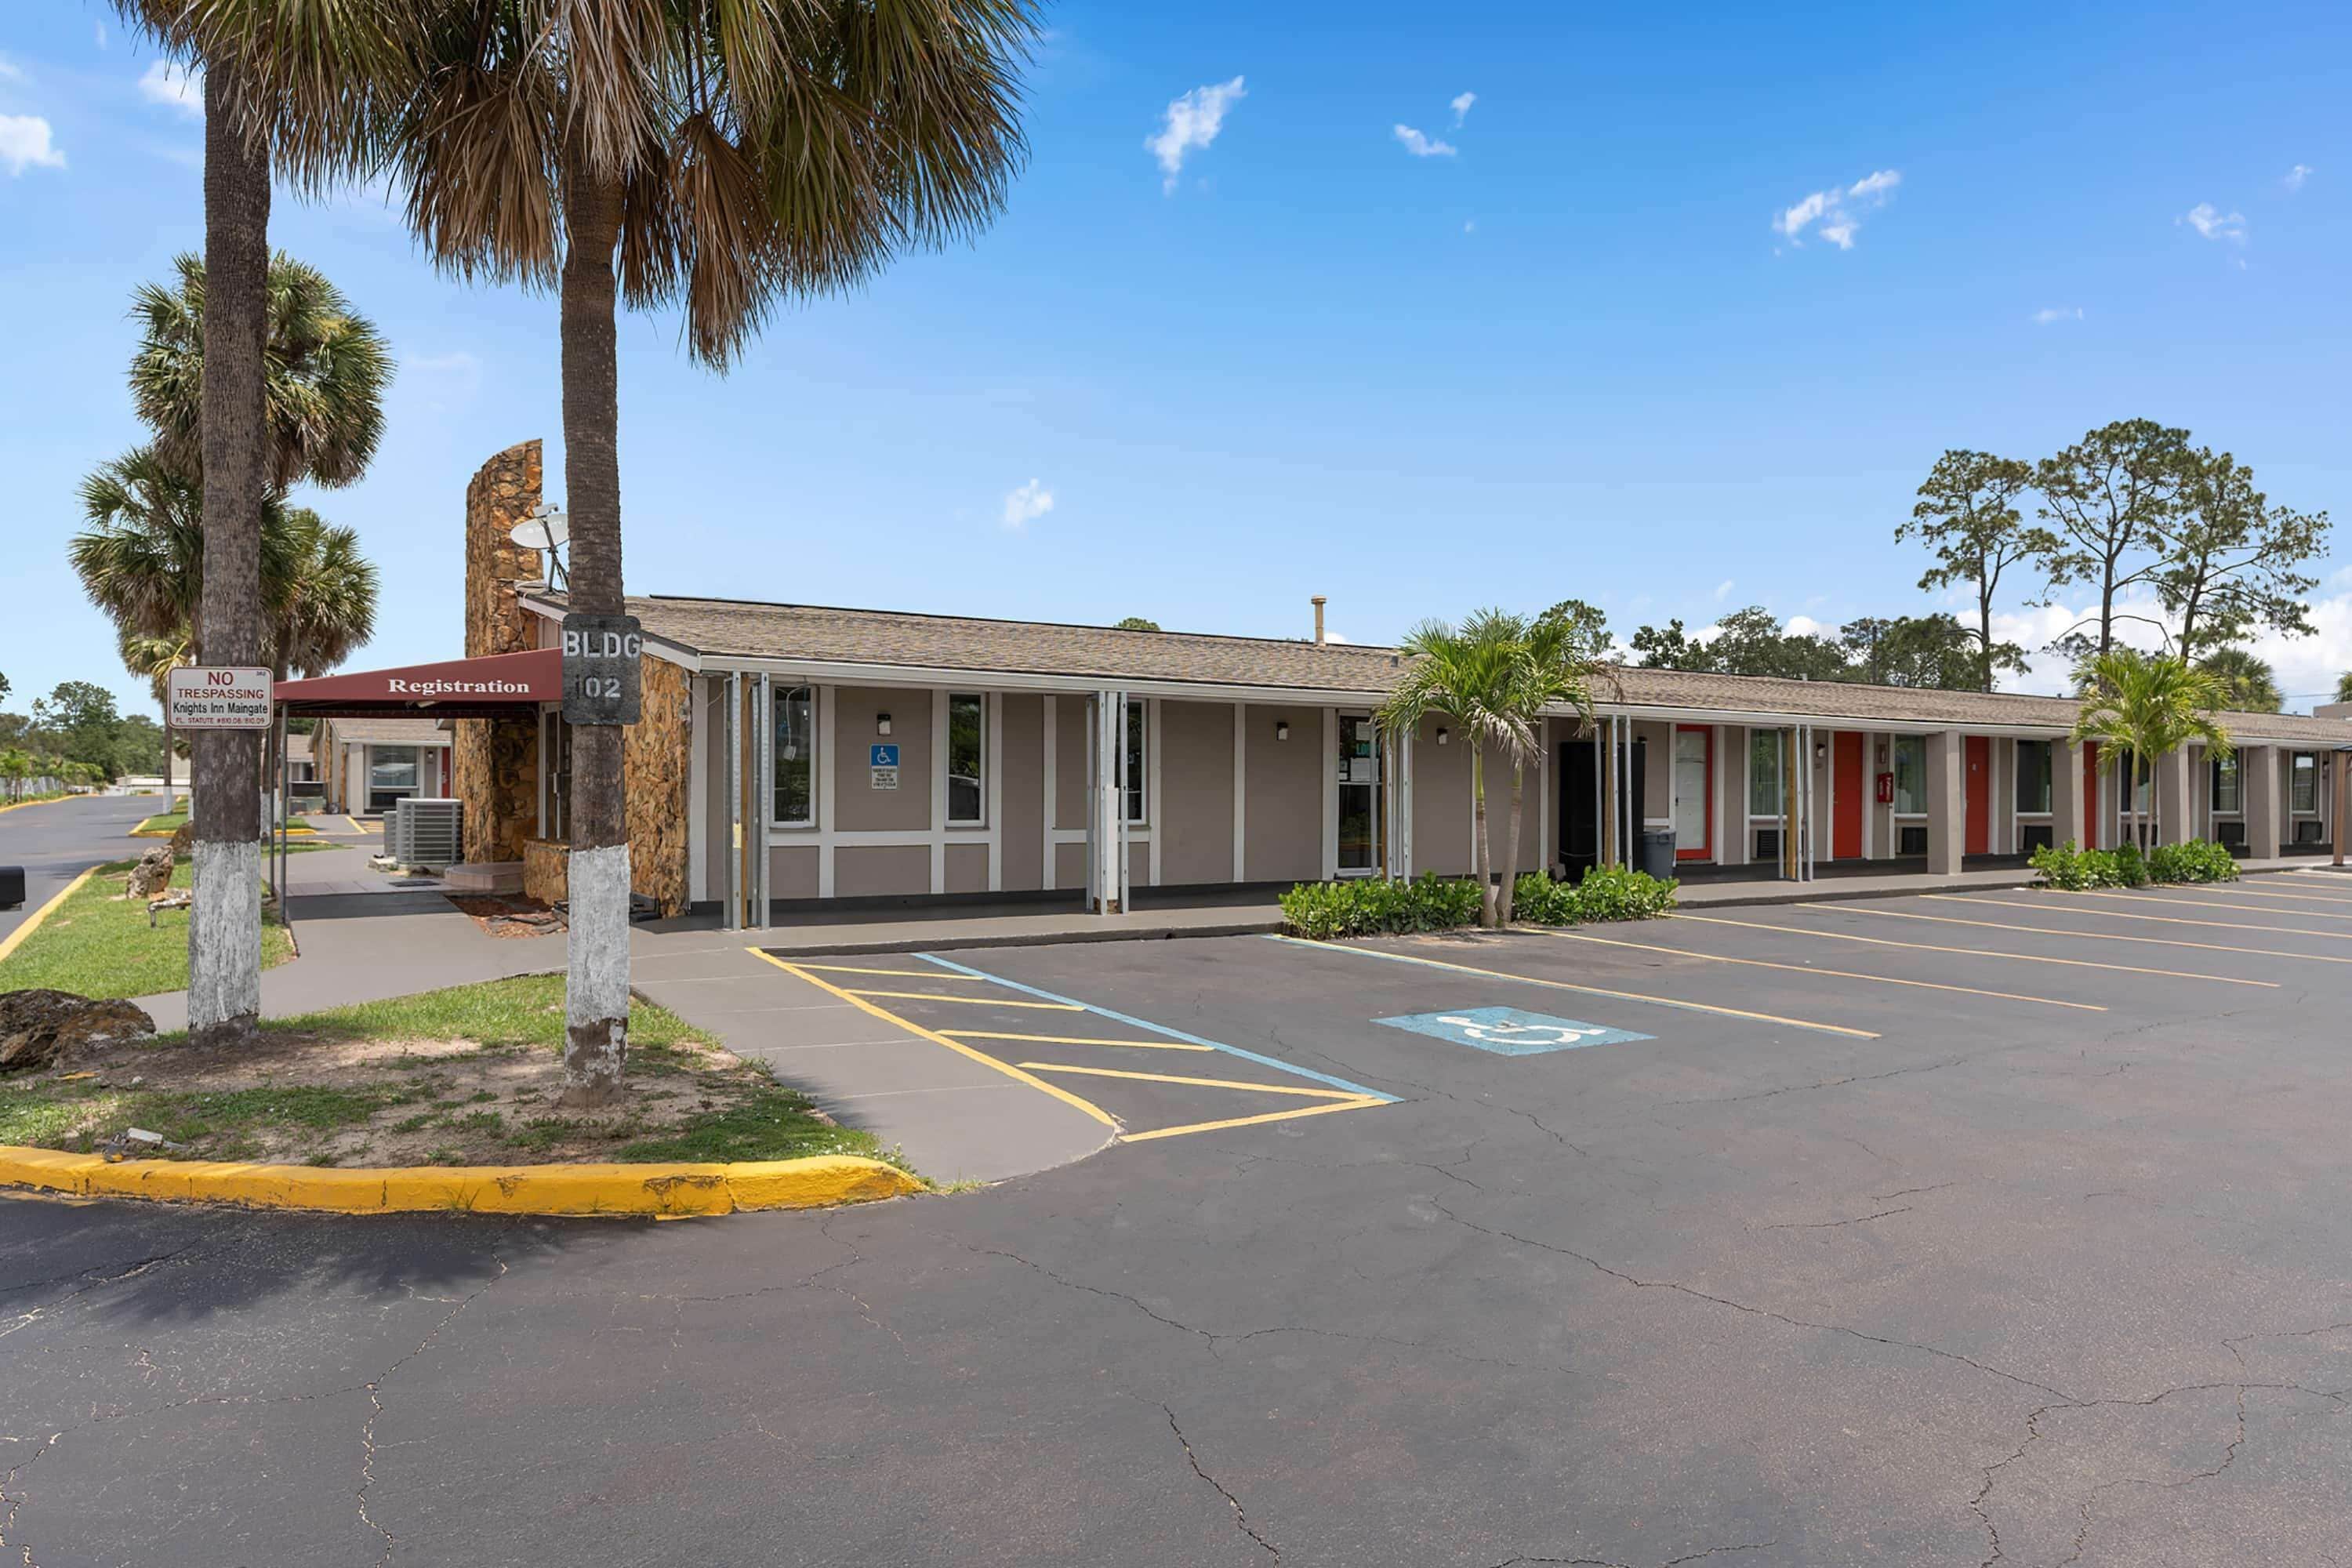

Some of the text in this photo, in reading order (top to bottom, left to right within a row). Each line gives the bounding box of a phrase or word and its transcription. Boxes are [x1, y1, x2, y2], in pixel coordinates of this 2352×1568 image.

[563, 630, 641, 658] BLDG
[208, 671, 234, 686] NO
[177, 688, 264, 699] TRESPASSING
[388, 679, 530, 696] Registration
[173, 702, 268, 717] Knights Inn Maingate
